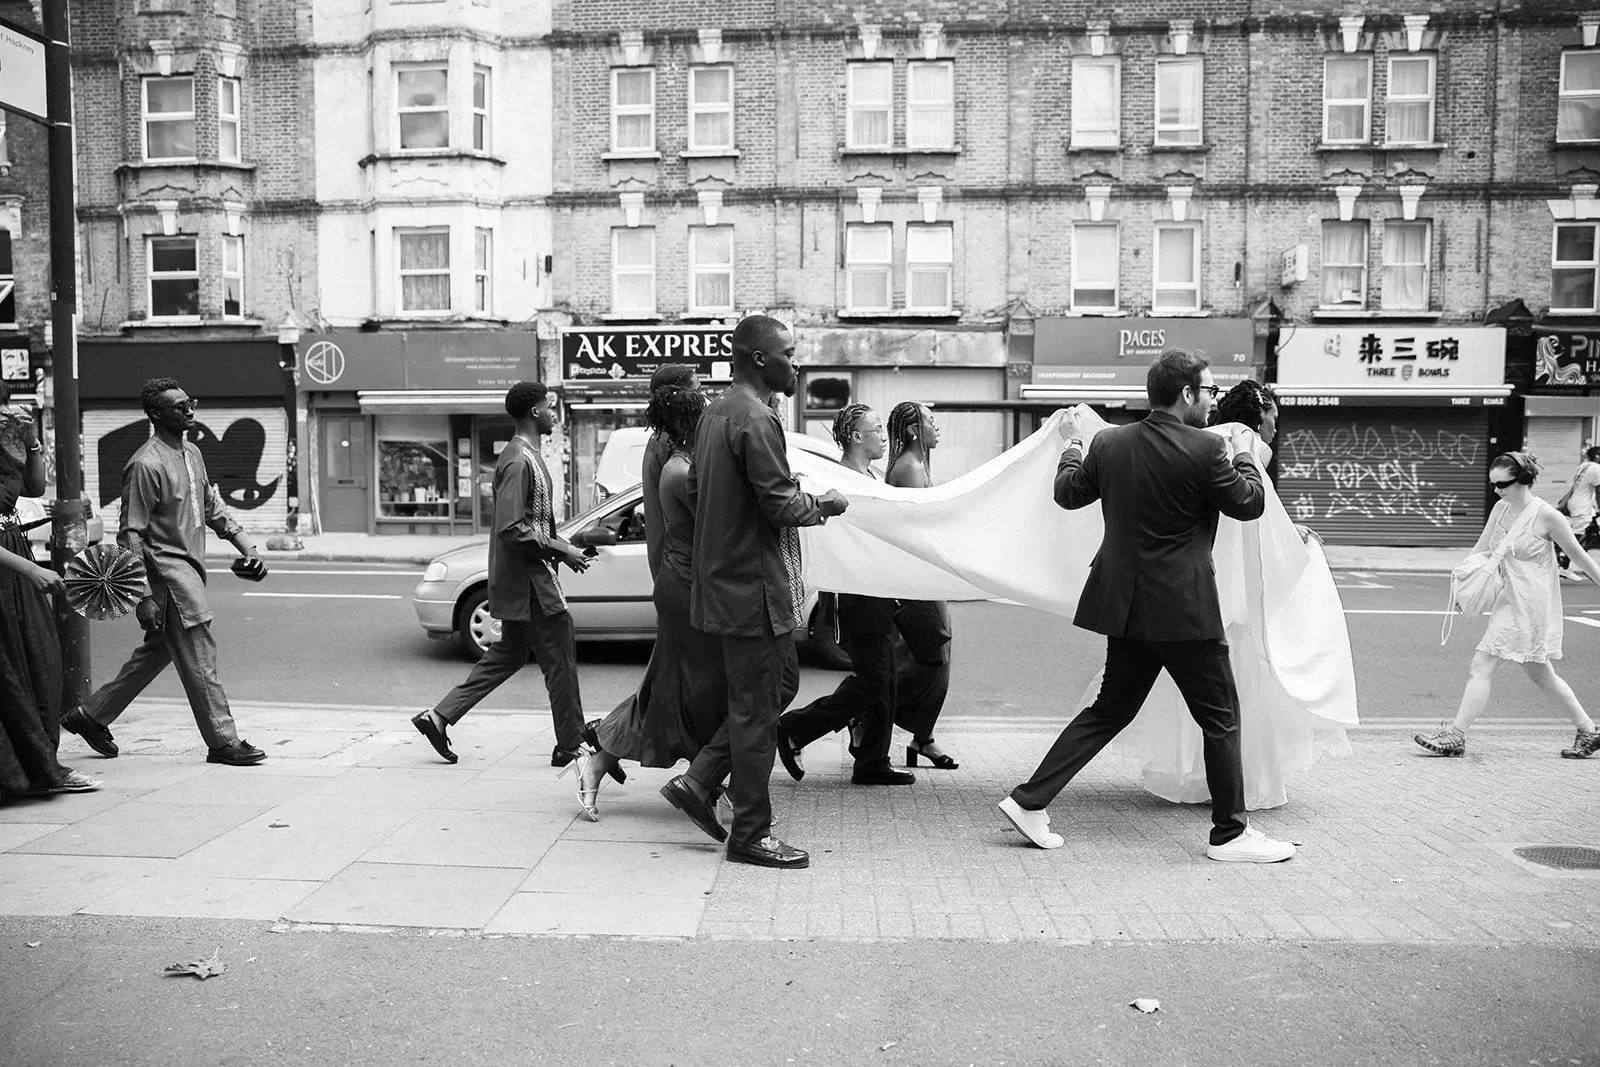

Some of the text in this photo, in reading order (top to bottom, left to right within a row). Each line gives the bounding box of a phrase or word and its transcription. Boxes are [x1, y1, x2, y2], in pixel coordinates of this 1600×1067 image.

[5, 35, 35, 55] Hackney
[575, 333, 733, 364] AK EXPRES
[1118, 329, 1166, 357] PAGES
[1359, 333, 1459, 364] 来三碗
[1232, 353, 1246, 362] 70
[1367, 367, 1450, 377] THREE BOWLS
[1280, 397, 1296, 406] 020
[1451, 397, 1504, 405] THREE BOWLS
